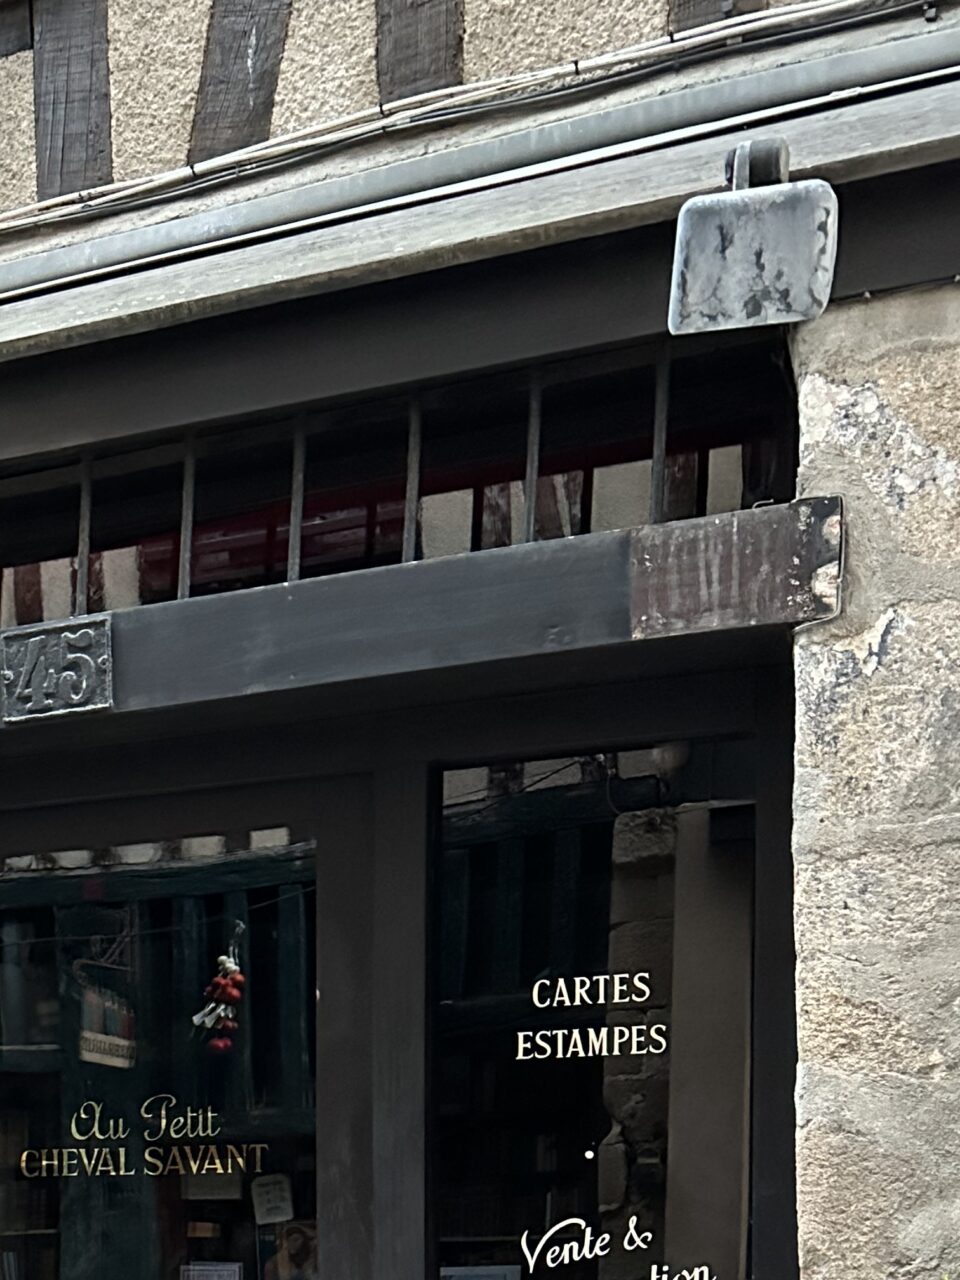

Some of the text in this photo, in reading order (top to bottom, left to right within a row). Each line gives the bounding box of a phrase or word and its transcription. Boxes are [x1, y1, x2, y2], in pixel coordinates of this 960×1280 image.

[14, 628, 96, 712] 45
[532, 972, 651, 1008] CARTES
[515, 1024, 668, 1060] ESTAMPES
[70, 1094, 222, 1142] Au Petit
[20, 1143, 270, 1178] CHEVAL SAVANT
[520, 1215, 653, 1274] Vente &
